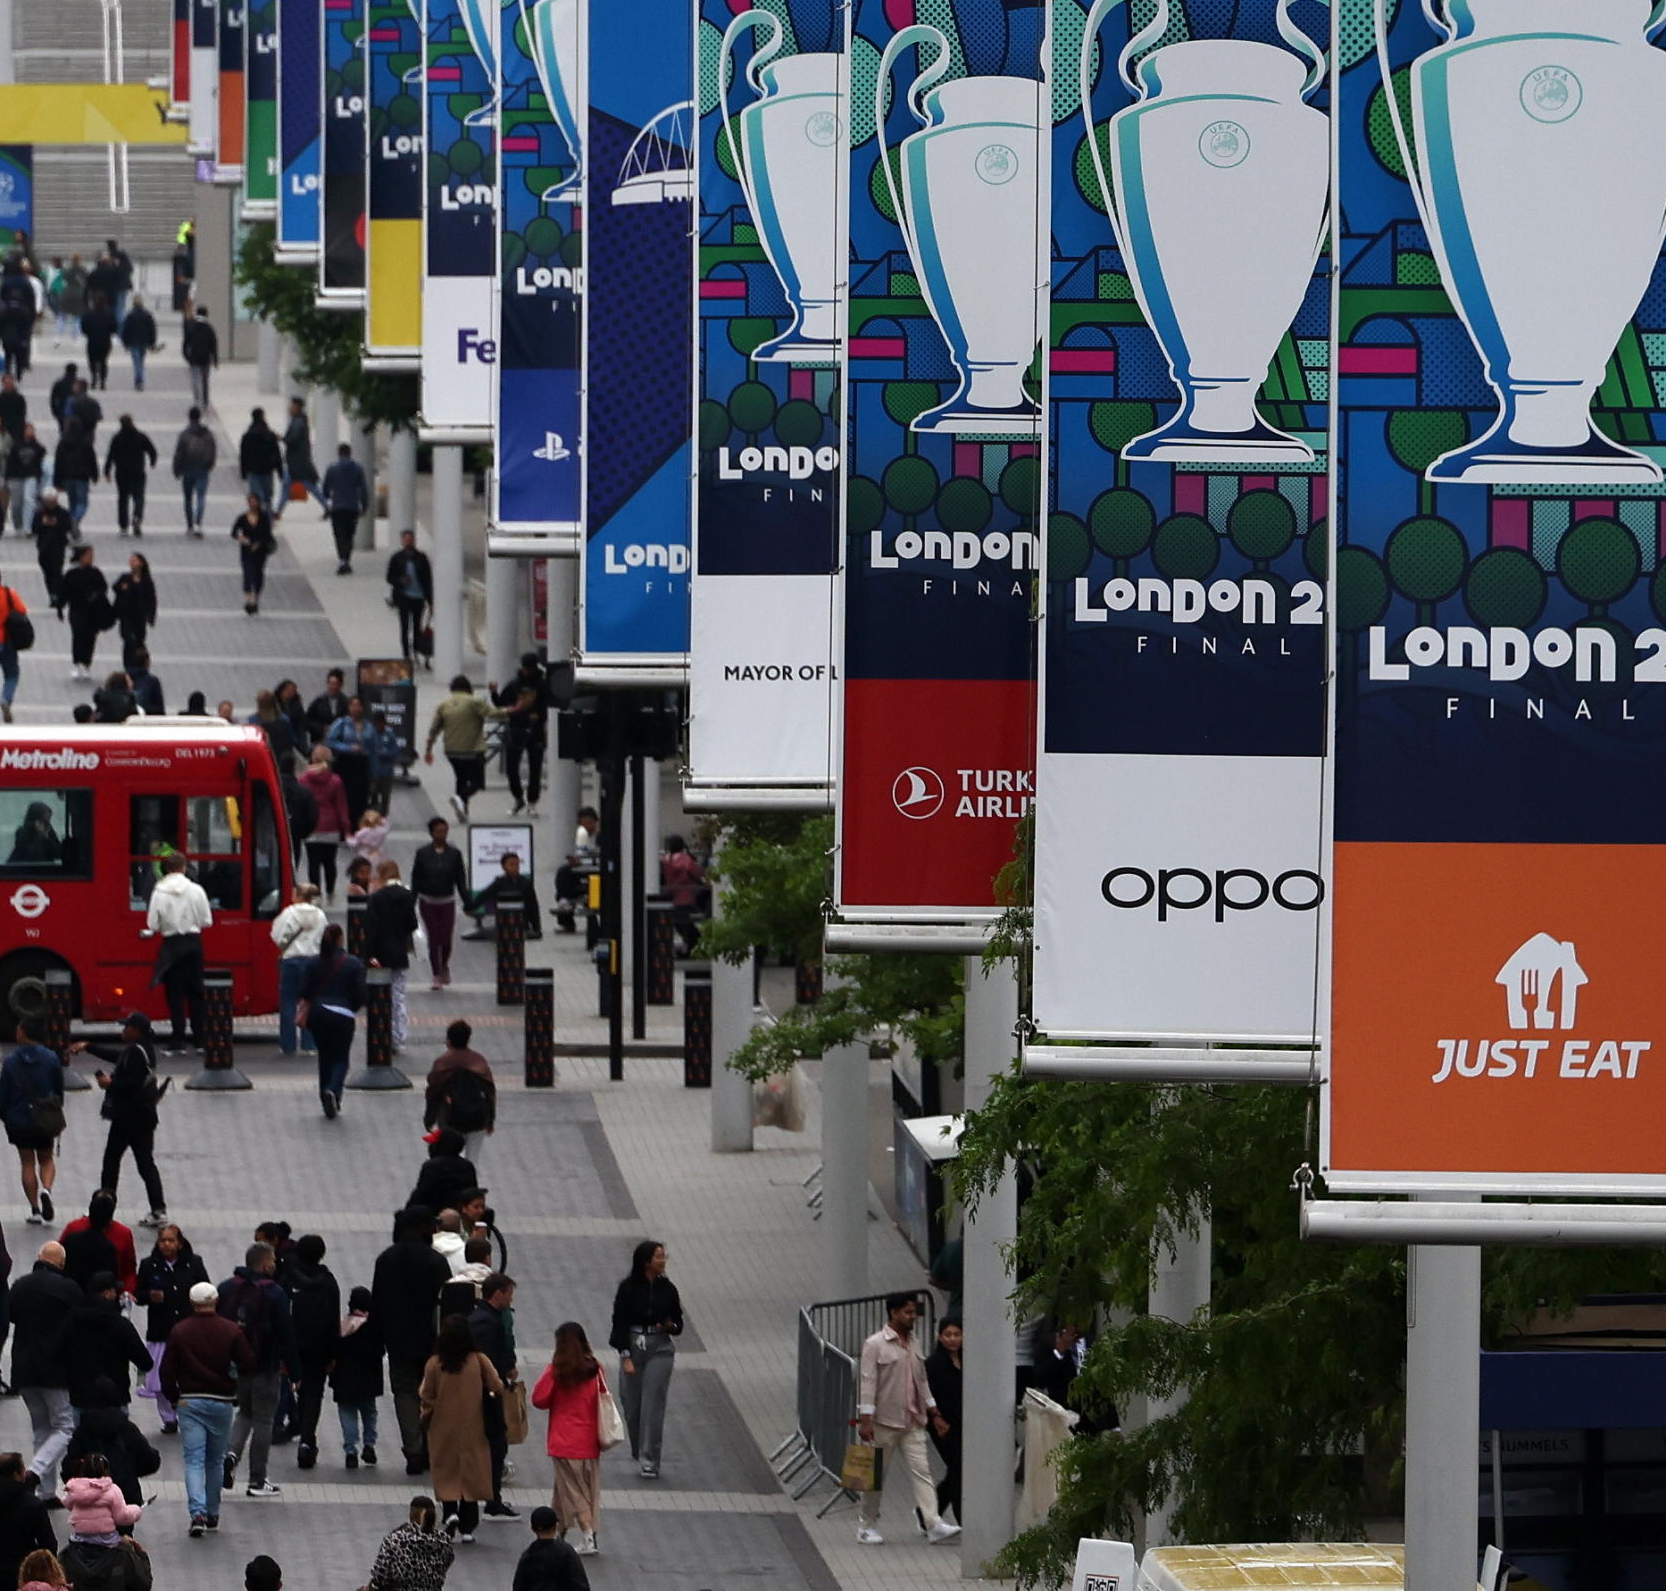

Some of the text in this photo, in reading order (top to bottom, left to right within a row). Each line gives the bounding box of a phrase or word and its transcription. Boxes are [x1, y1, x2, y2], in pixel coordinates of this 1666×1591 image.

[441, 185, 497, 210] Lon
[719, 446, 840, 480] LonDo
[763, 489, 823, 503] FIN
[924, 581, 1023, 595] FINA
[1290, 577, 1323, 624] 2
[1137, 635, 1291, 655] FINAL
[724, 664, 826, 682] MAYOR OF
[1446, 698, 1635, 720] FINAL
[0, 747, 100, 770] Metroline
[956, 769, 1036, 792] TURK
[954, 796, 1037, 819] AIRLI
[1101, 866, 1326, 923] oppo
[1432, 1039, 1652, 1084] JUST EAT
[1499, 1439, 1570, 1453] UMMELS
